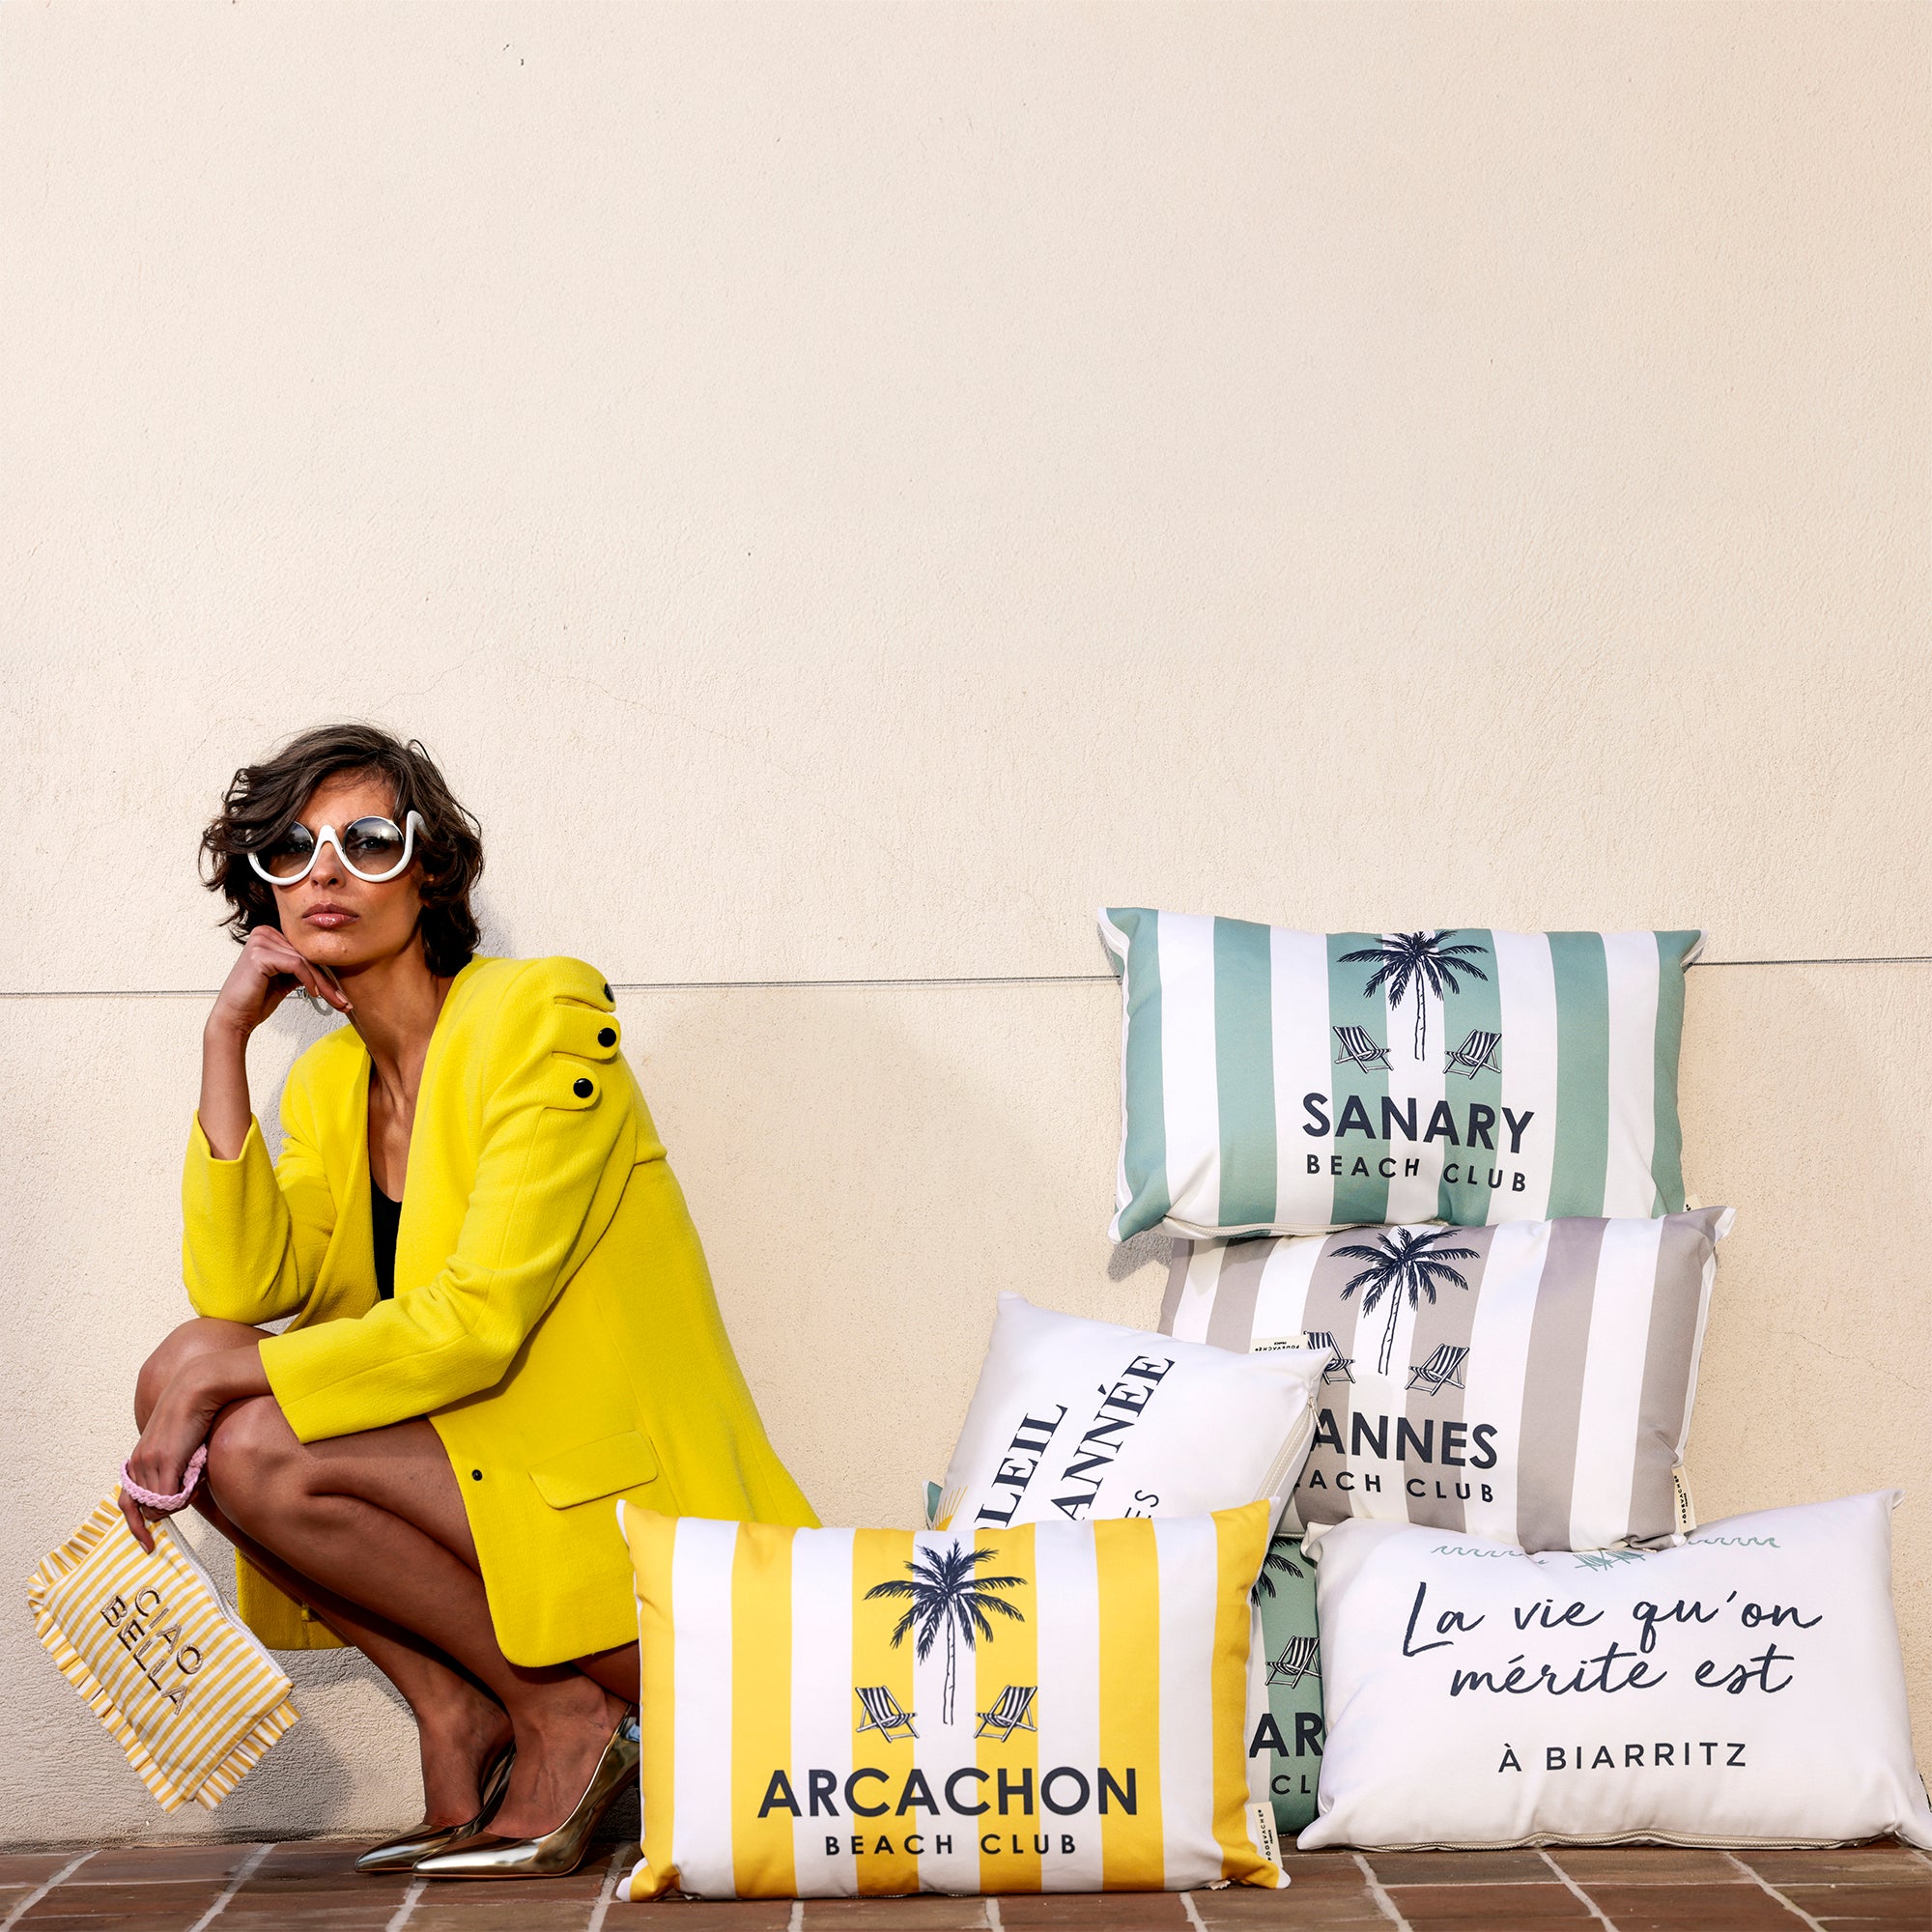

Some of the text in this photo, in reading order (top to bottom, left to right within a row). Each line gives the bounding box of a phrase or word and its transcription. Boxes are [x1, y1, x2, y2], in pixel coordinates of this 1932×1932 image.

[1302, 1092, 1534, 1153] SANARY
[1306, 1154, 1526, 1192] BEACH CLUB
[973, 1404, 1069, 1529] LEIL
[1310, 1408, 1498, 1469] ANNES
[1294, 1469, 1494, 1503] ACH CLUB
[134, 1586, 204, 1675] CIAO
[1403, 1581, 1823, 1658] La vie qu'on
[99, 1595, 188, 1717] BELLA
[1450, 1641, 1795, 1697] mérite est
[1271, 1775, 1311, 1795] CL
[1497, 1742, 1747, 1774] À BIARRITZ
[756, 1766, 1138, 1818] ARCACHON
[824, 1833, 1077, 1856] BEACH CLUB
